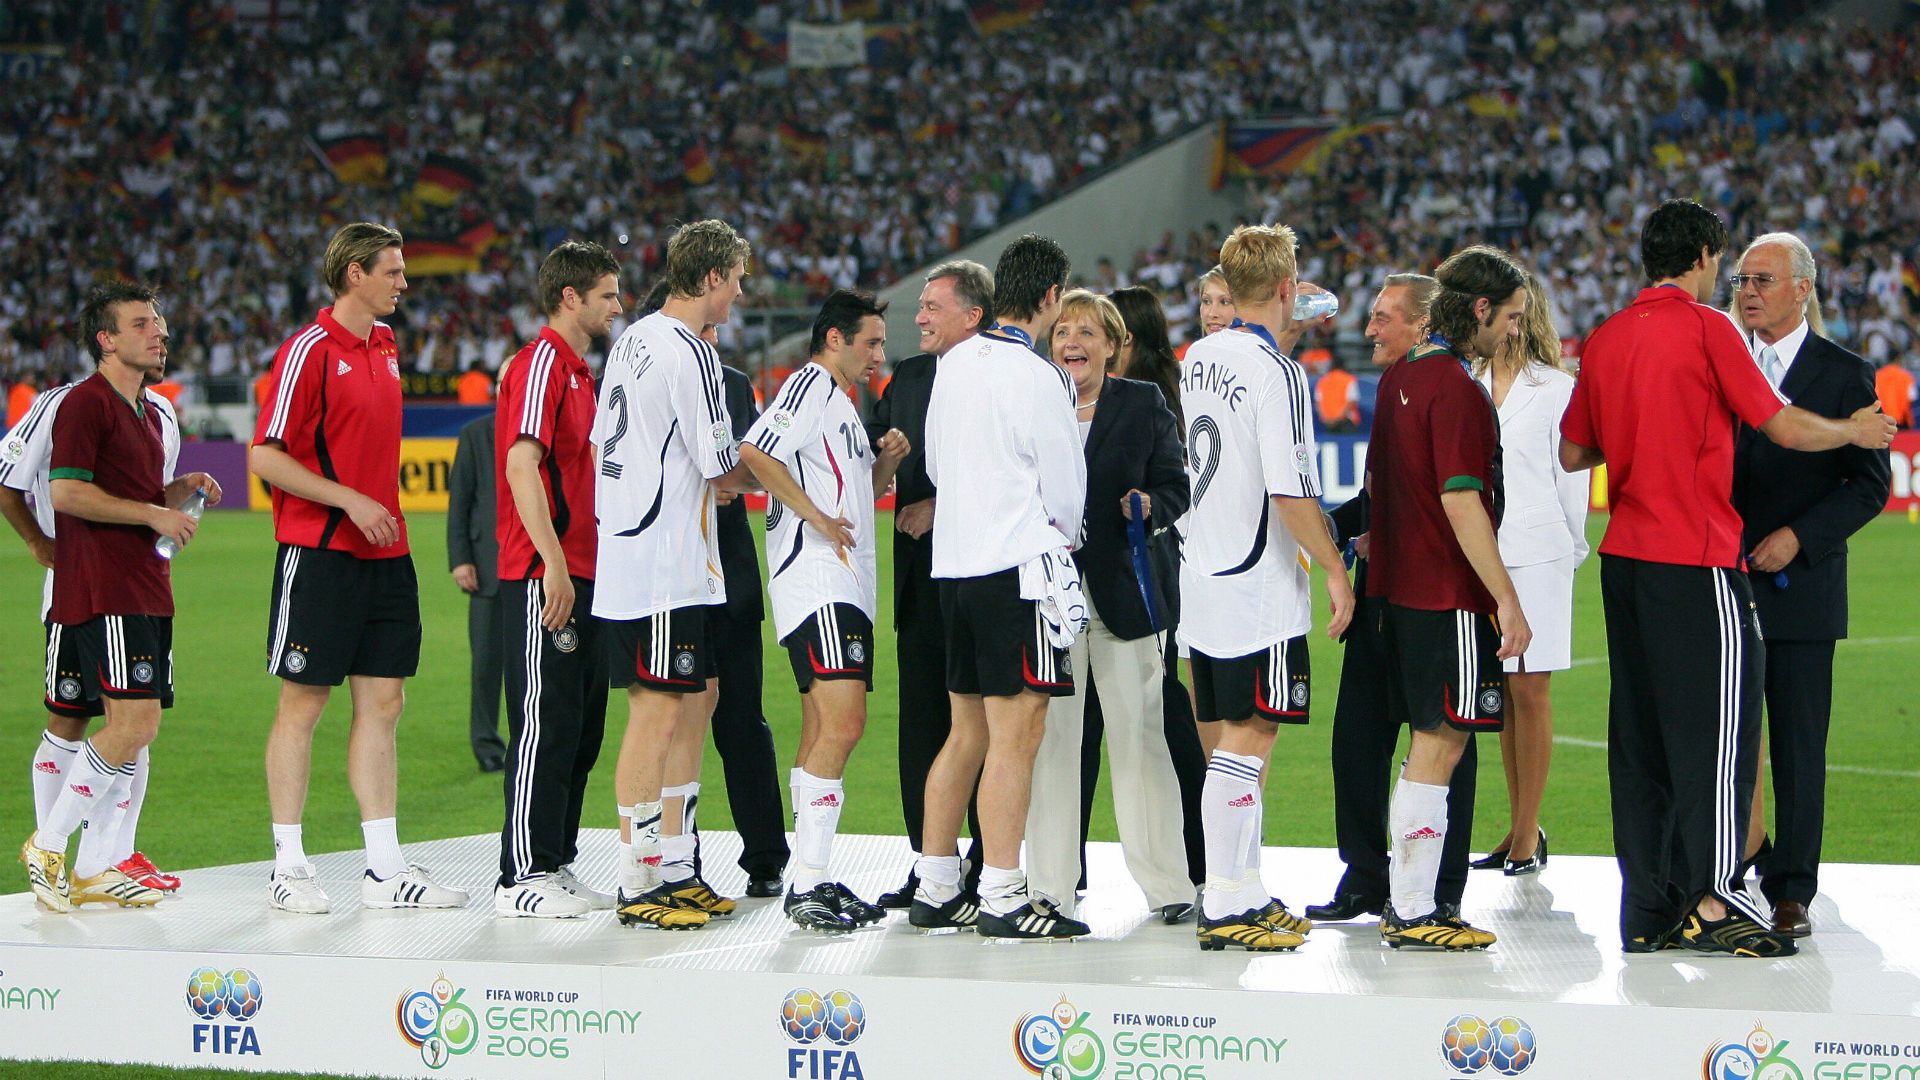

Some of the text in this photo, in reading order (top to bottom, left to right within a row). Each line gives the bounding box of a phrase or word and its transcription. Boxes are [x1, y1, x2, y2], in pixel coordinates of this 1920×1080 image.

[602, 384, 629, 480] 2
[1189, 414, 1222, 511] 9
[486, 989, 579, 1004] FIFA WORLD CUP
[485, 1006, 642, 1035] GERMANY
[1113, 1013, 1217, 1029] FIFA WORLD CUP
[193, 1023, 262, 1056] FIFA
[486, 1034, 570, 1059] 2006
[1112, 1031, 1288, 1063] GERMANY
[1814, 1041, 1847, 1055] FIFA
[1849, 1042, 1900, 1057] WORLD
[788, 1048, 865, 1080] FIFA
[1114, 1061, 1207, 1080] 2006
